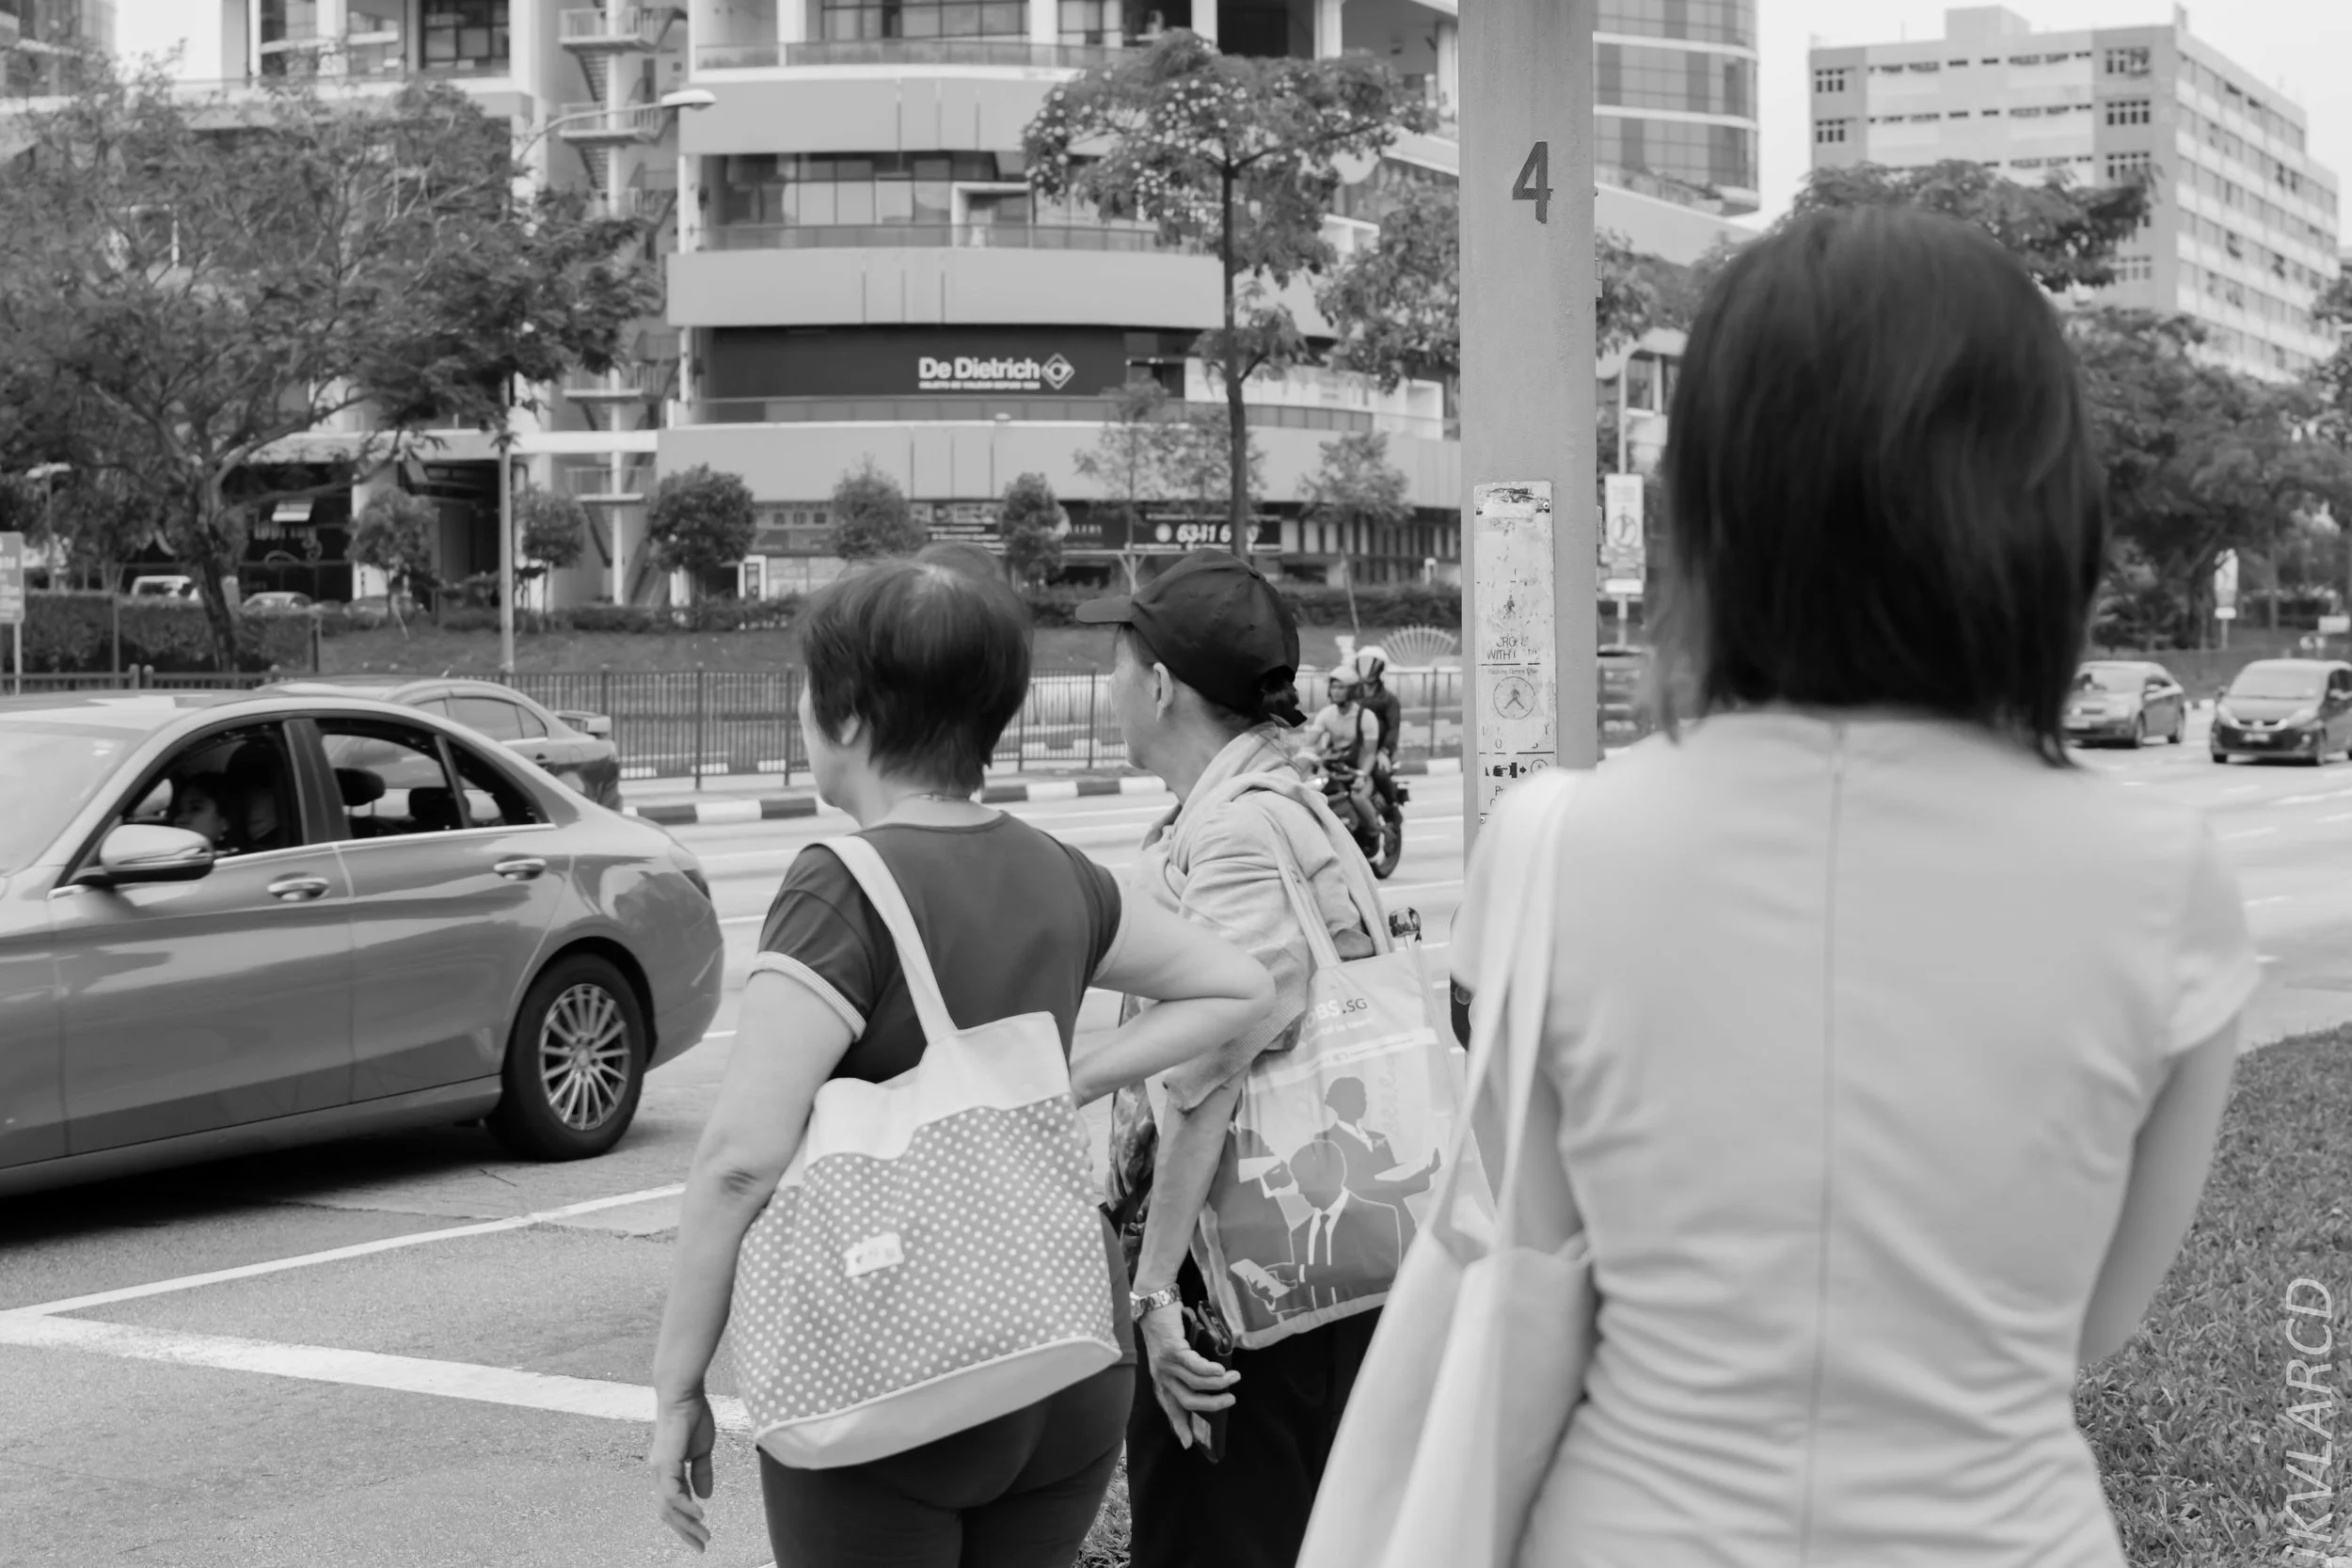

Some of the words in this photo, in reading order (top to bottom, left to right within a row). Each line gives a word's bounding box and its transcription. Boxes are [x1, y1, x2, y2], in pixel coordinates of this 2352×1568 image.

[1513, 141, 1553, 224] 4
[918, 356, 952, 379] De
[954, 356, 1041, 379] Dietrich
[1487, 649, 1511, 659] WITH
[1302, 998, 1368, 1033] OBS.SG
